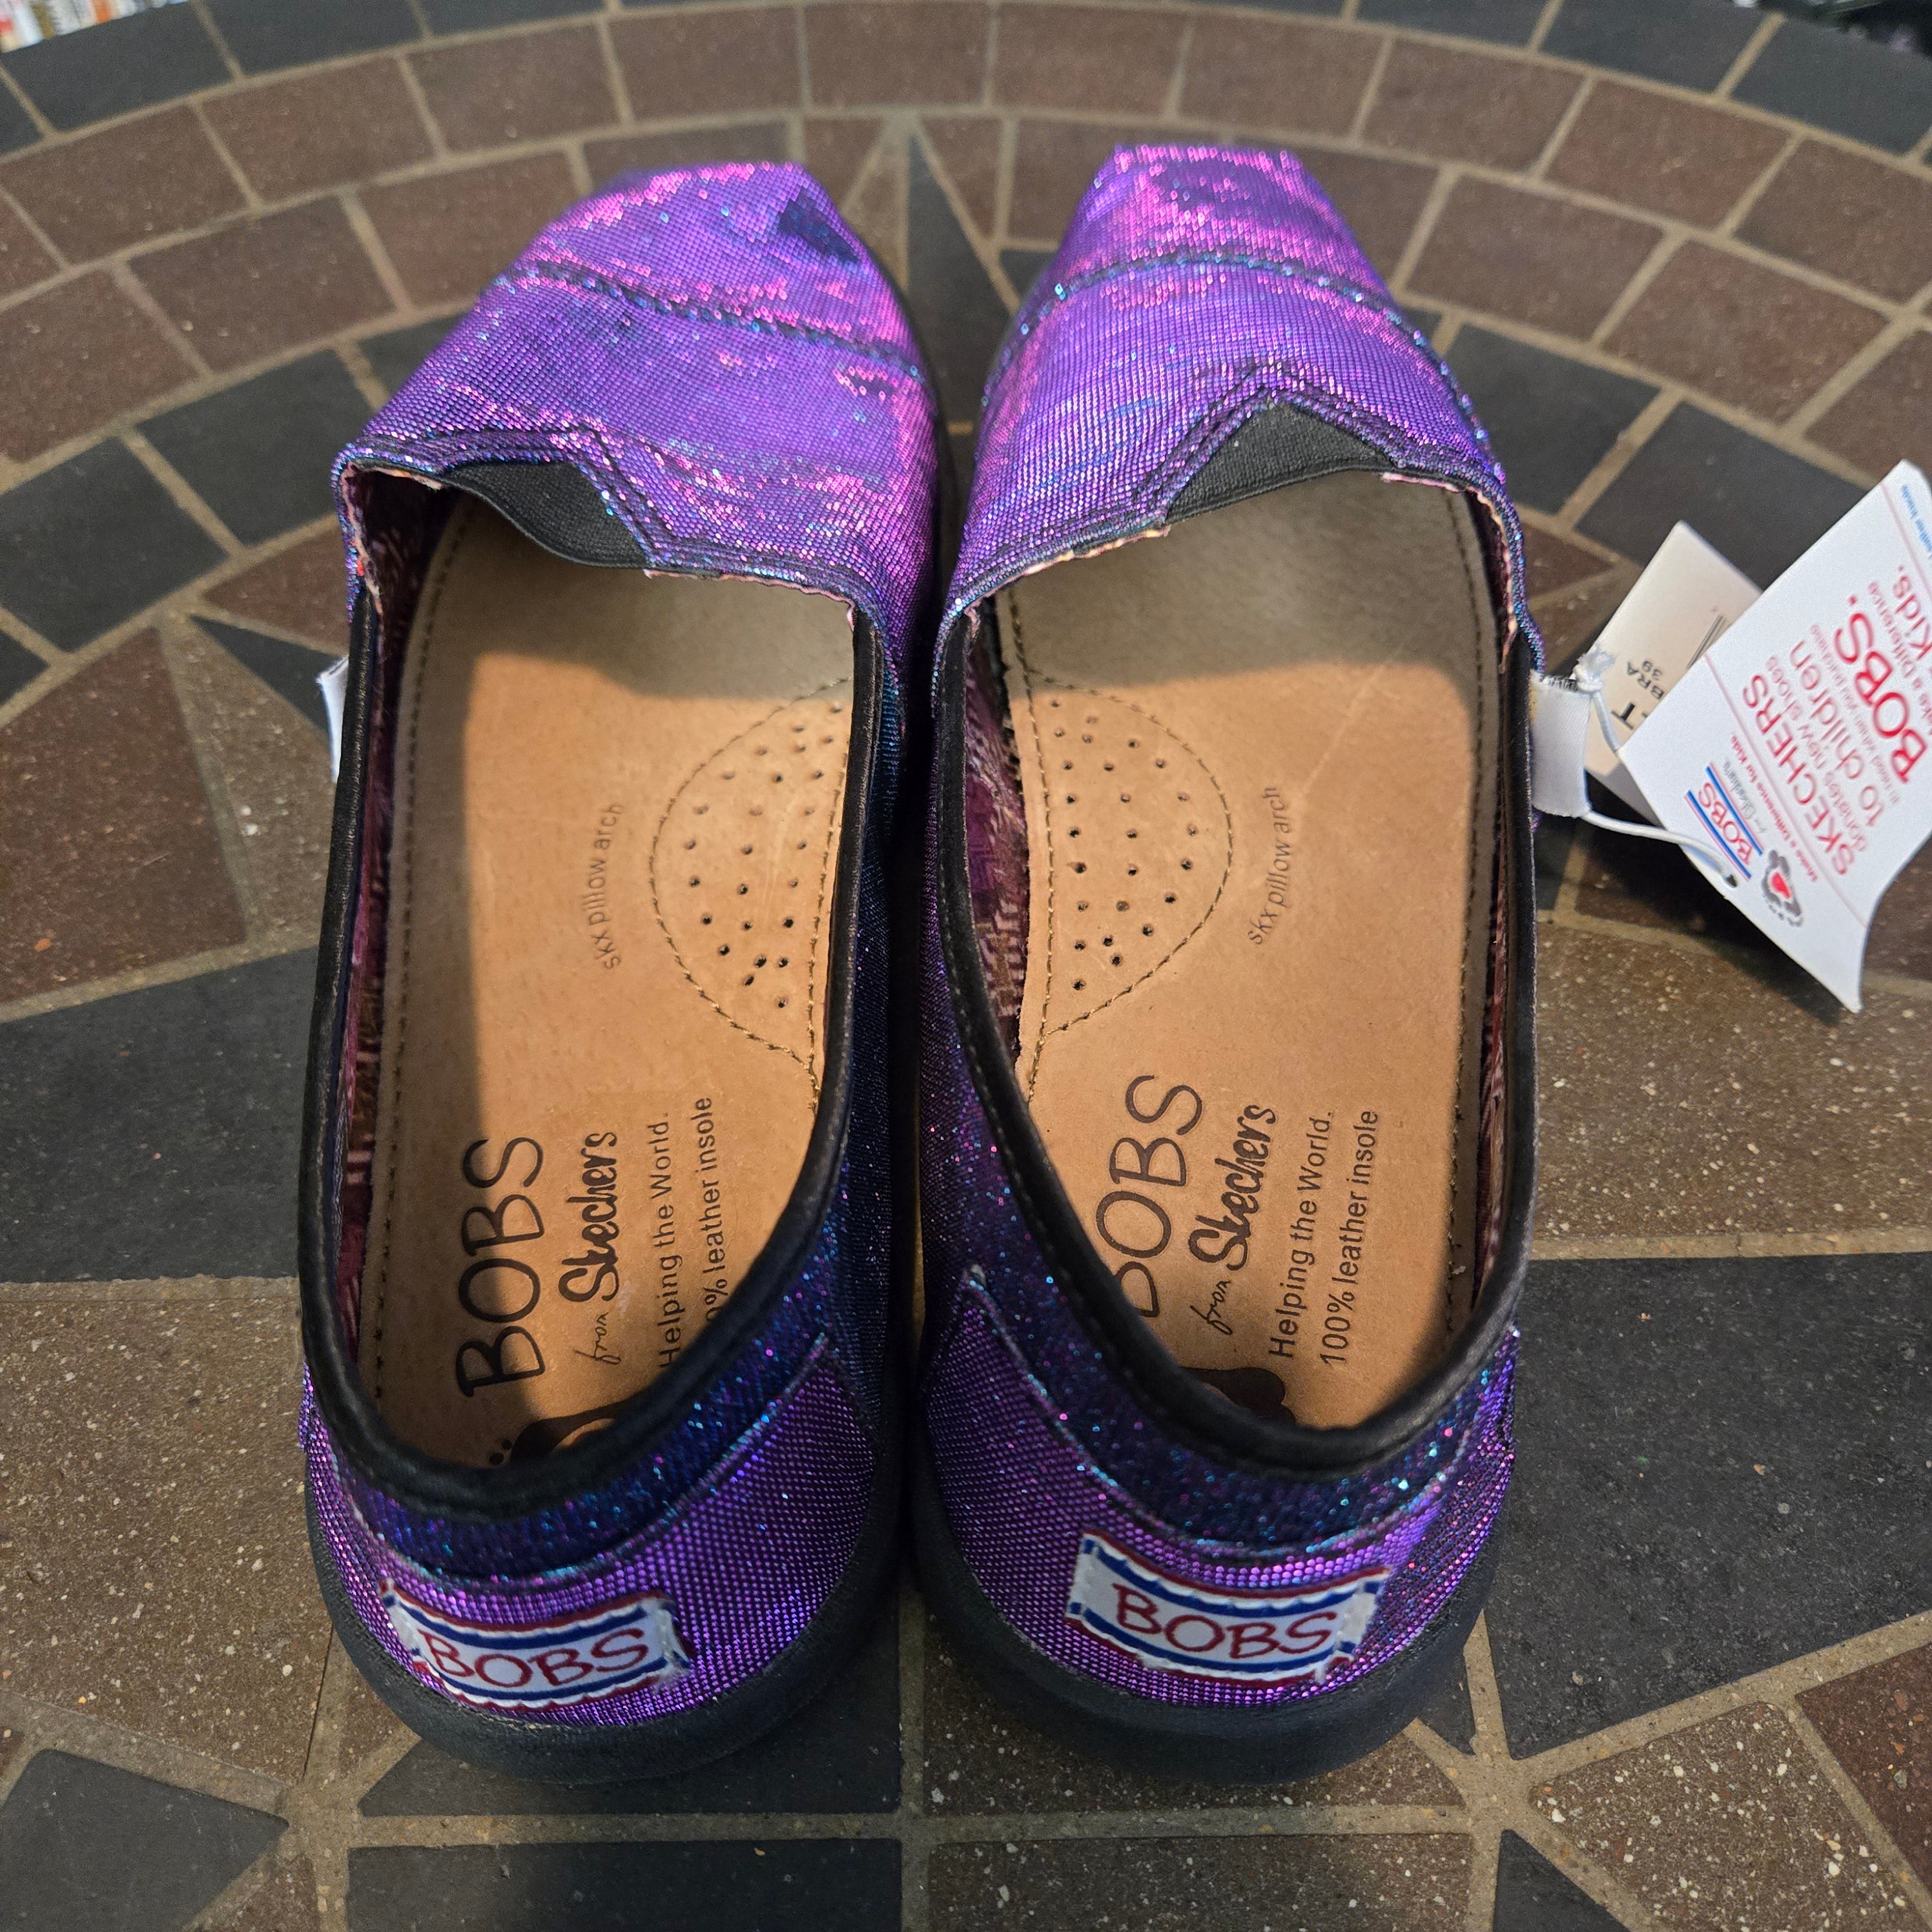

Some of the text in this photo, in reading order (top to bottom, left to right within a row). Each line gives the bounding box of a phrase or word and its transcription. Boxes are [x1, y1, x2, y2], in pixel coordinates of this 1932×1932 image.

[1642, 661, 1662, 680] 39
[1834, 594, 1927, 783] BOBS.
[1867, 581, 1915, 678] Difference
[1893, 565, 1932, 661] Kids.
[1743, 675, 1855, 874] SKECHERS
[1765, 655, 1867, 851] donates new shoes
[1790, 640, 1884, 827] to children
[582, 805, 623, 969] skx pillow arch
[1248, 788, 1293, 945] skx pillow arch
[1698, 782, 1753, 865] BOBS
[690, 1097, 719, 1173] insole
[1187, 1104, 1277, 1335] from Skechers
[456, 1137, 545, 1397] BOBS
[557, 1131, 622, 1365] from Skechers
[647, 1113, 686, 1368] Helping the World.
[698, 1180, 726, 1275] leather
[1269, 1112, 1333, 1357] Helping the World.
[1320, 1110, 1379, 1364] 100% leather insole
[417, 1627, 648, 1688] BOBS
[1112, 1582, 1337, 1659] BOBS
